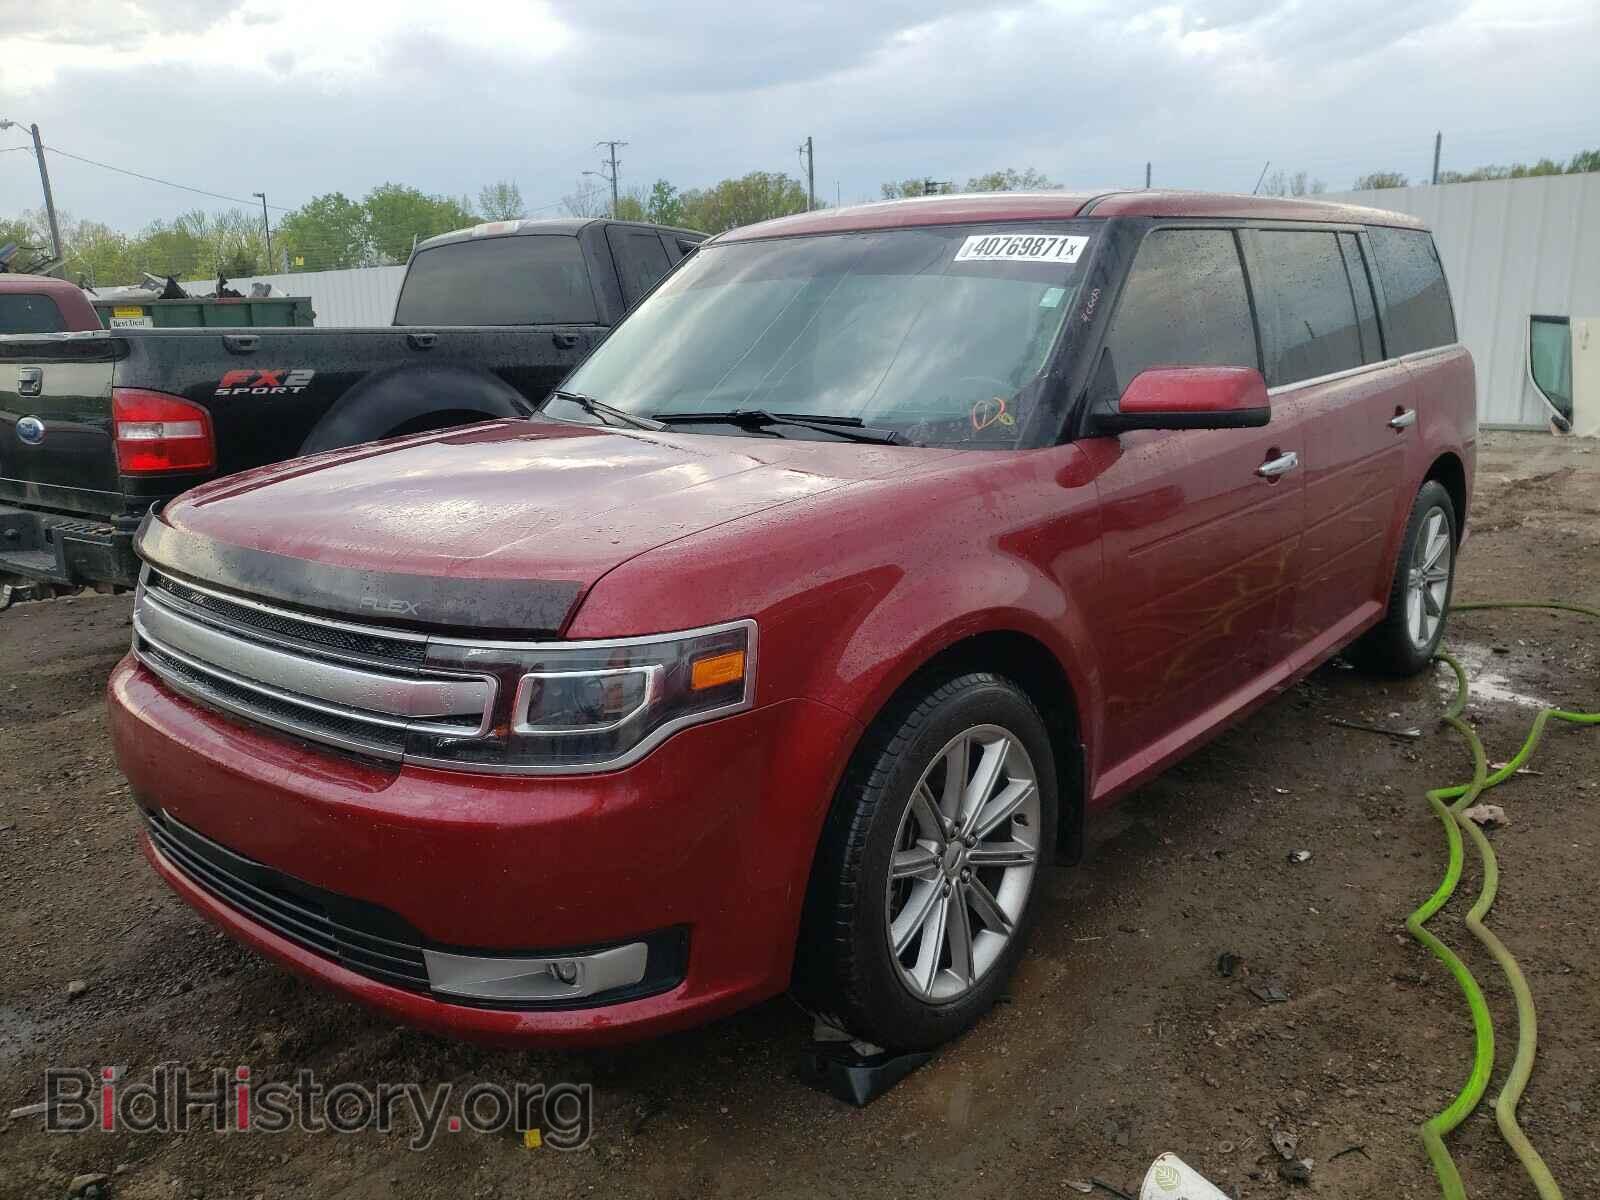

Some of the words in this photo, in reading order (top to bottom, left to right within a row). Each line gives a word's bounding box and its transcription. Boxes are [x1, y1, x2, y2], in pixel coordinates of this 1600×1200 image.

[218, 369, 315, 387] FX2
[214, 386, 307, 396] SPORT
[359, 598, 419, 615] FLEX
